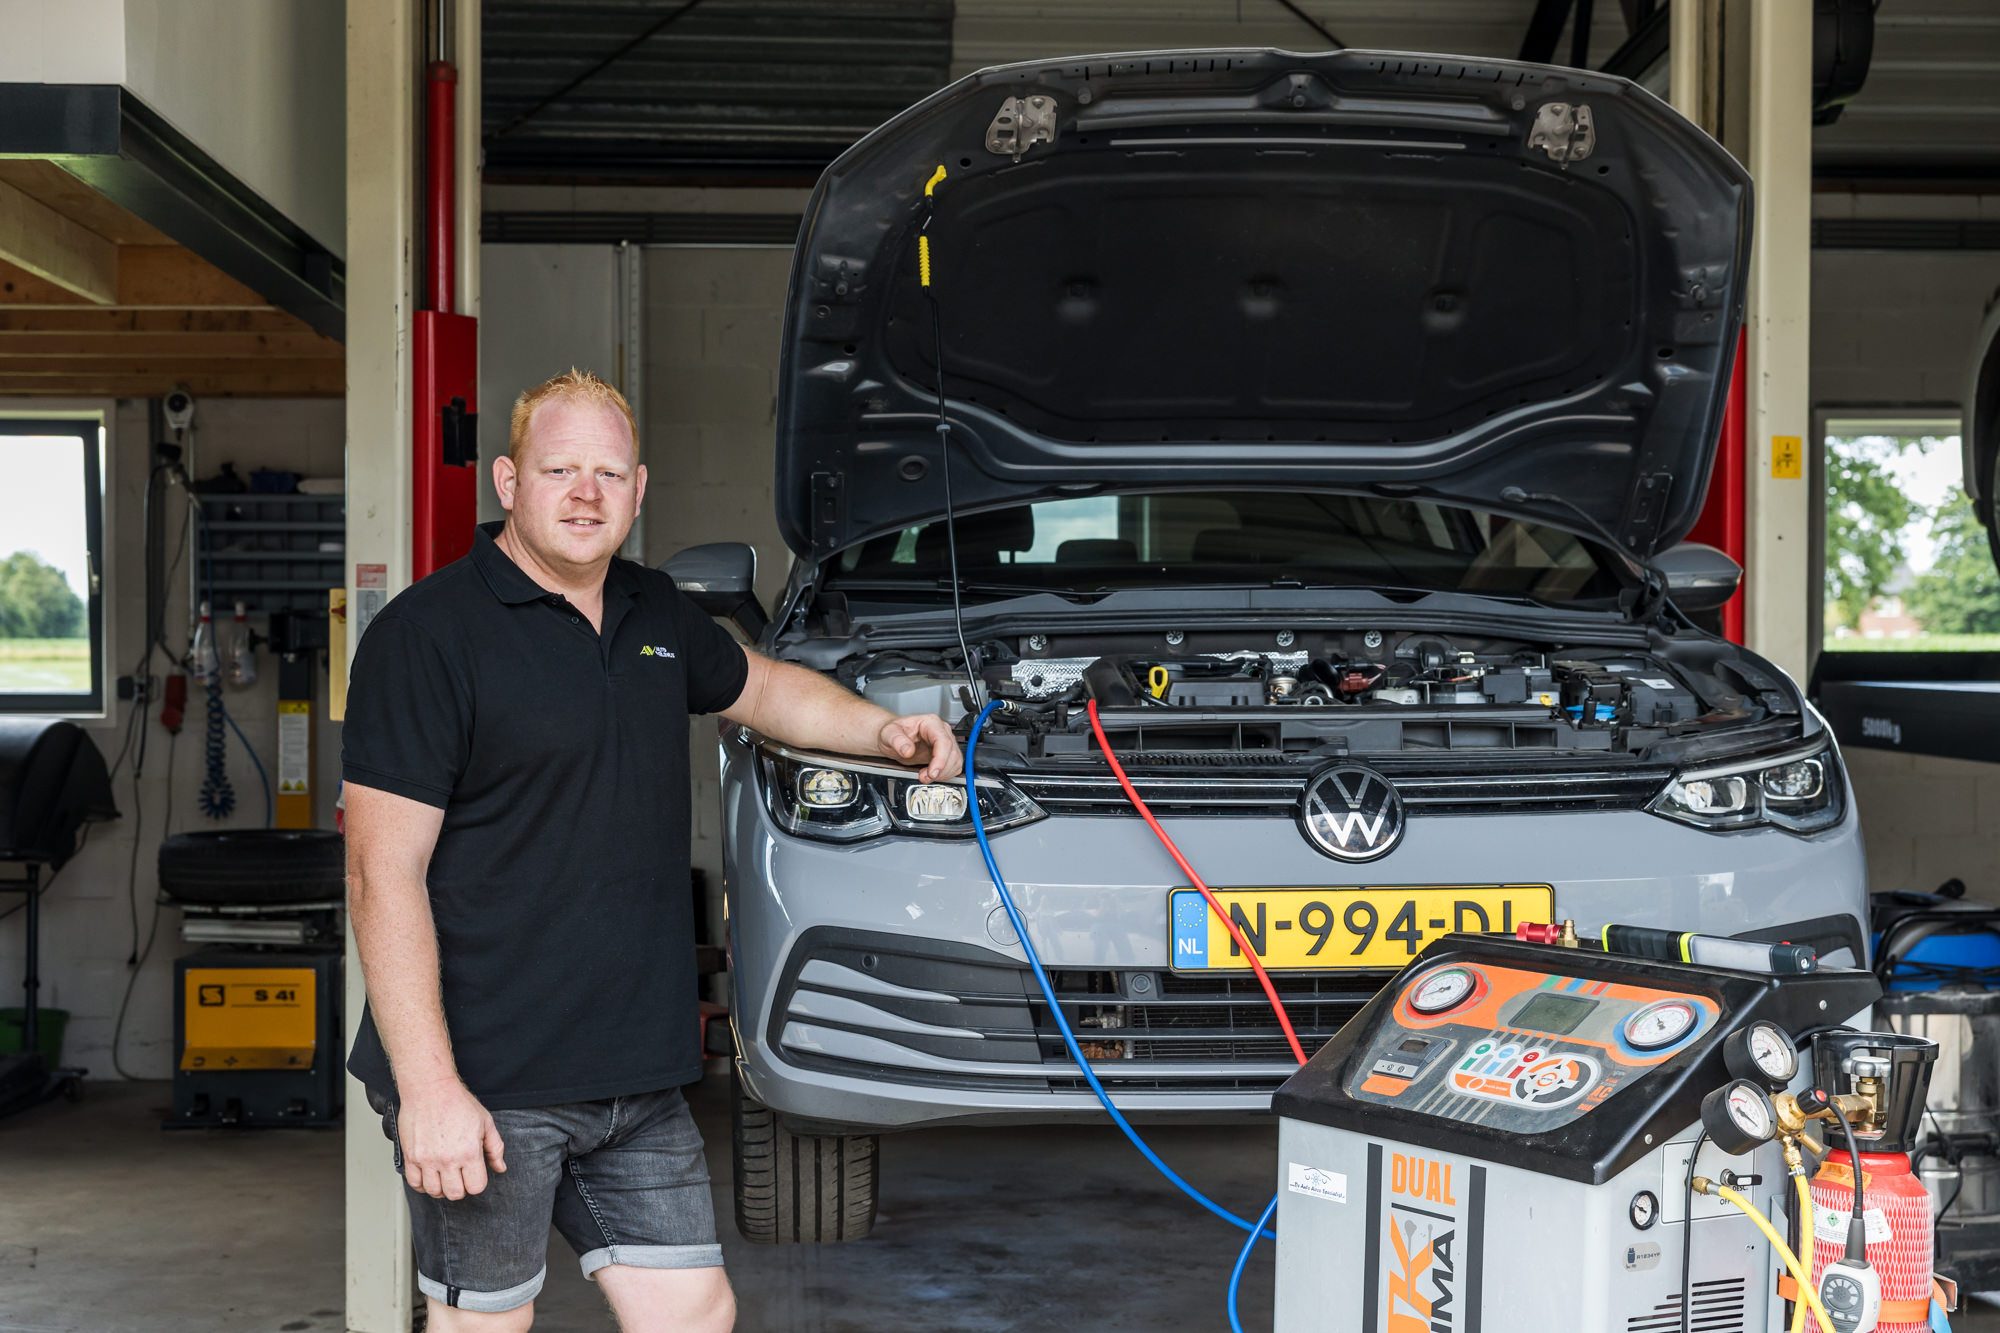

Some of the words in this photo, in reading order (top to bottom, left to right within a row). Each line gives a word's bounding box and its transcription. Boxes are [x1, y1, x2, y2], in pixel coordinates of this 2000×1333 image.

[1178, 938, 1203, 955] NL
[254, 989, 268, 1001] S
[275, 989, 295, 1001] 41
[1392, 1152, 1456, 1206] DUAL
